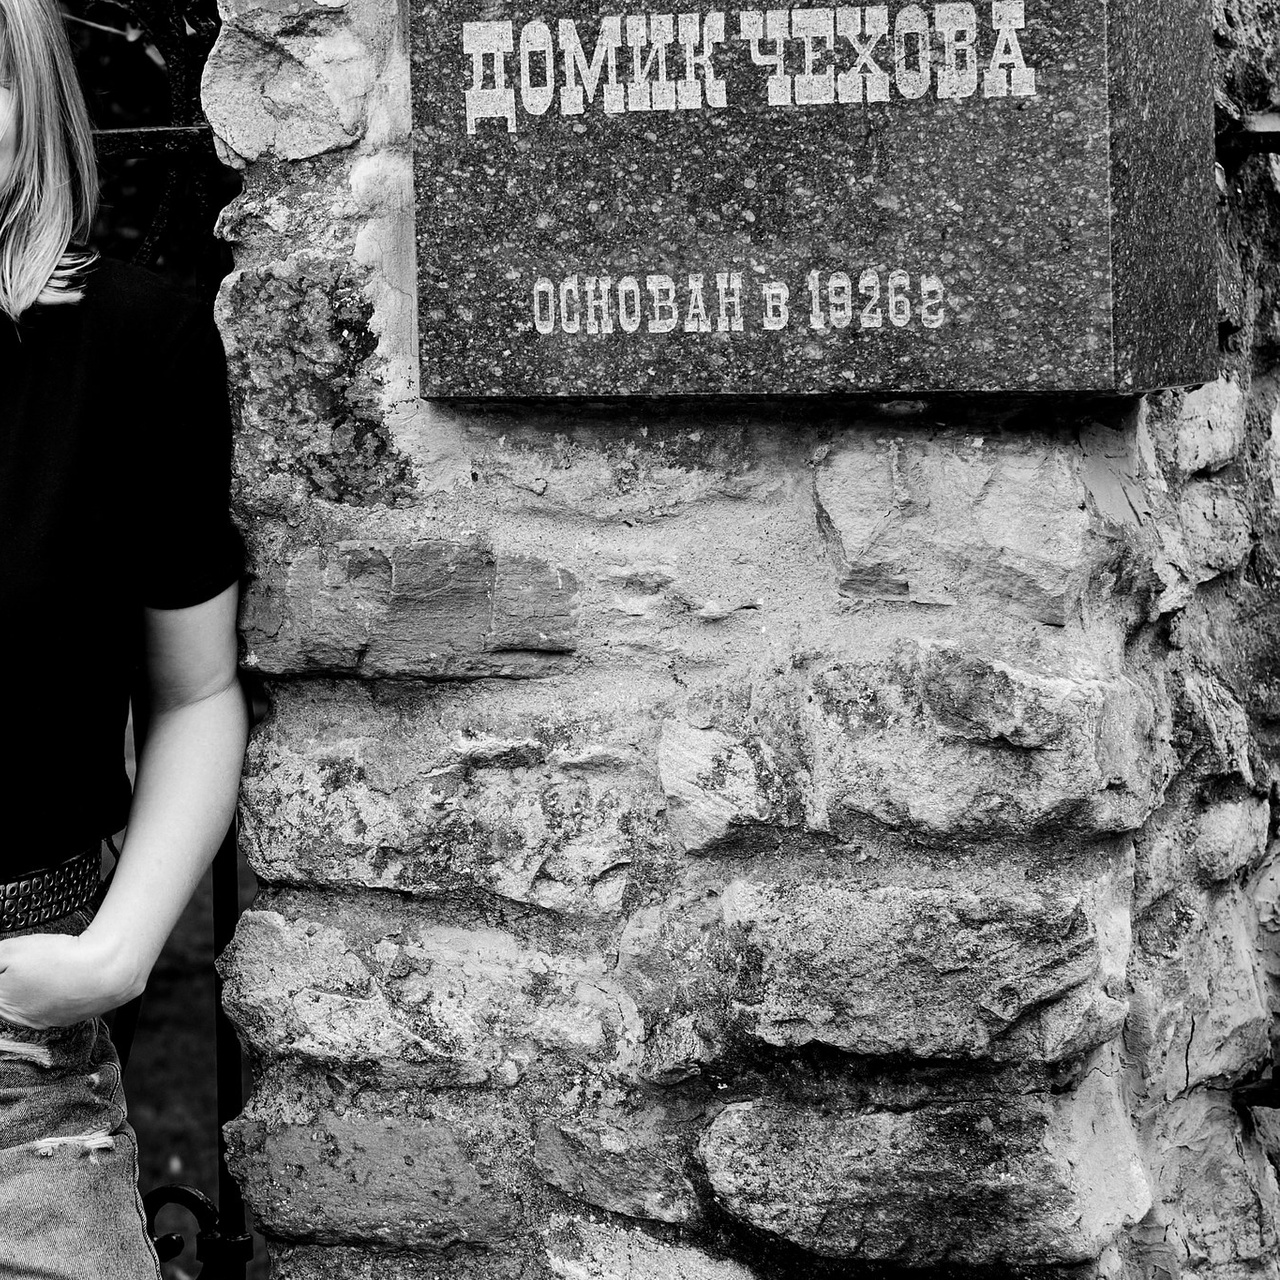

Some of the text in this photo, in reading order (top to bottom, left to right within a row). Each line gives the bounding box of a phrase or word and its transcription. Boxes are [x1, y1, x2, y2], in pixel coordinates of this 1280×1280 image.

[463, 0, 1037, 134] ДОМИК ЧЕХОВА
[533, 273, 744, 334] ОСНОВАН
